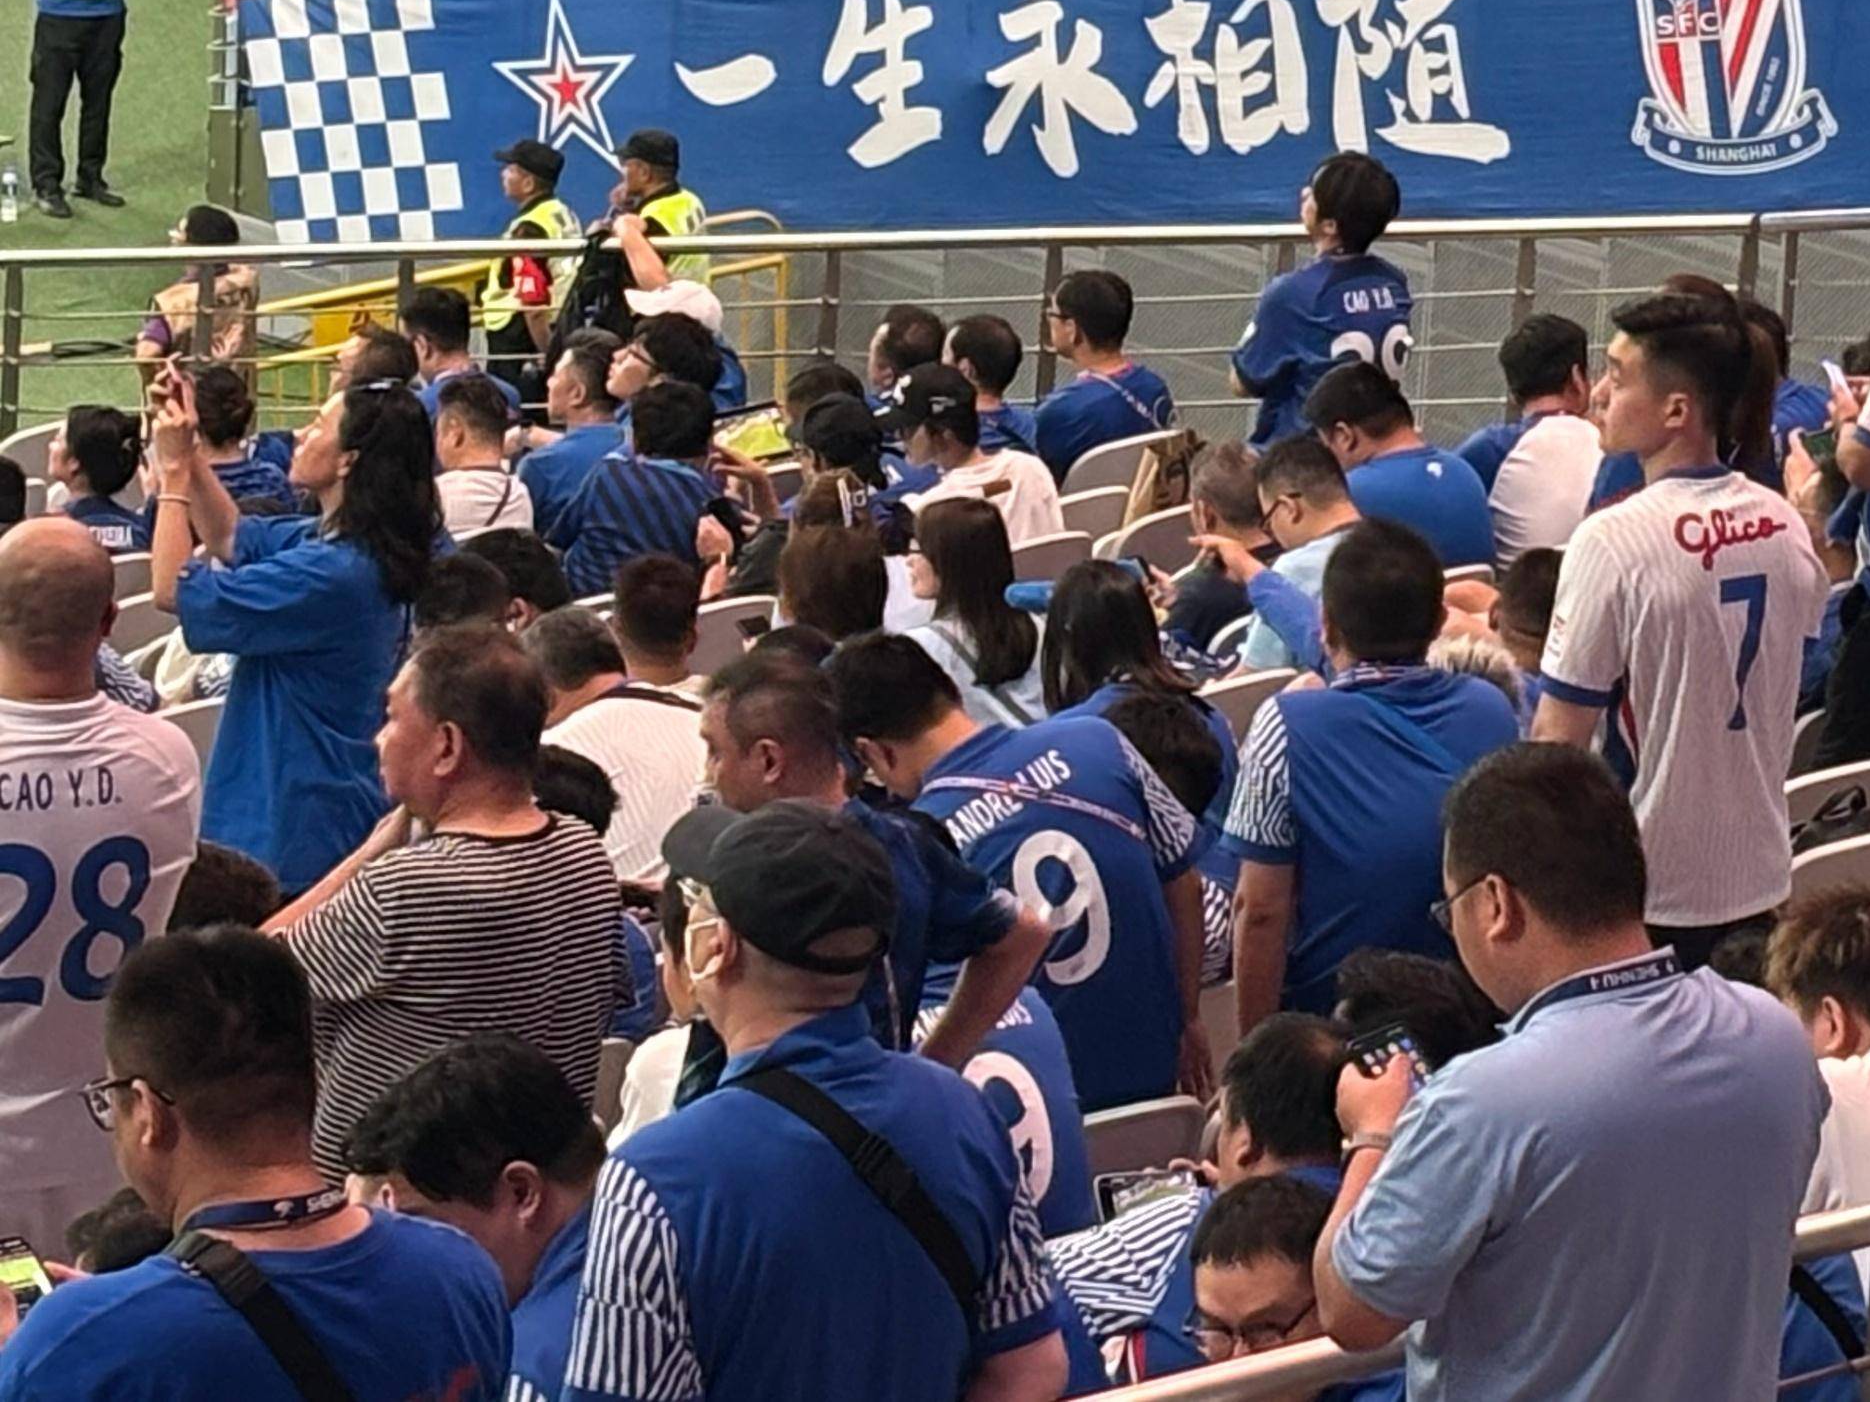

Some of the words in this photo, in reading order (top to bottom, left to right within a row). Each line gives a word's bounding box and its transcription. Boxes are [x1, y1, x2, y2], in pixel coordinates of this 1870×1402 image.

[1656, 11, 1719, 36] SFC
[1695, 143, 1778, 164] SHANGHAI
[1674, 509, 1788, 571] Glico
[1719, 574, 1768, 731] 7
[0, 772, 53, 811] CAO
[67, 765, 123, 809] Y.D.
[0, 834, 152, 1006] 28
[1012, 829, 1112, 986] 9
